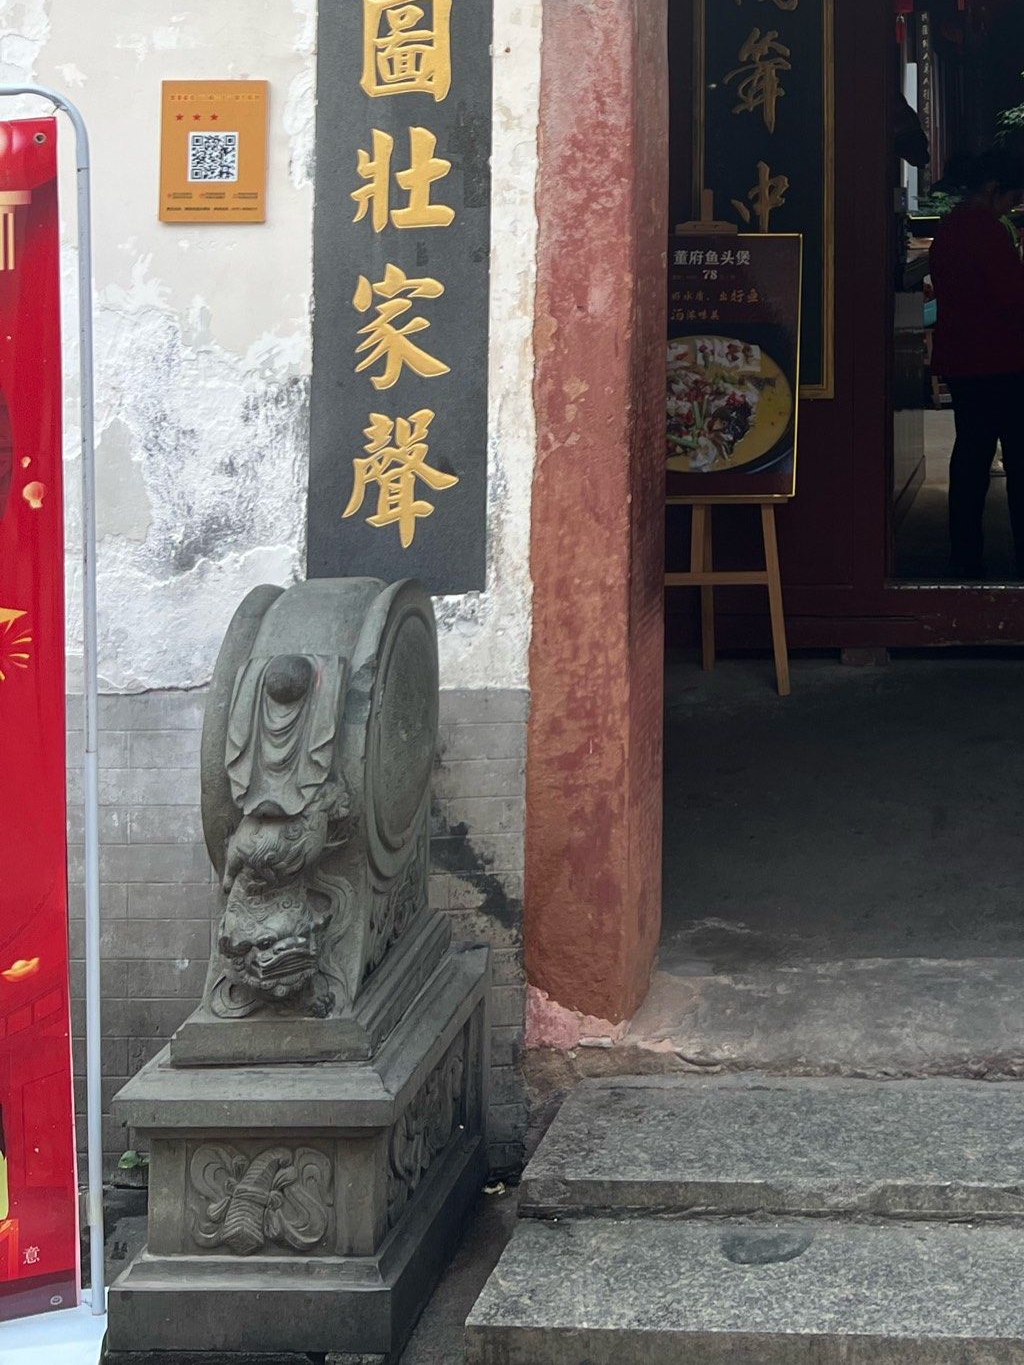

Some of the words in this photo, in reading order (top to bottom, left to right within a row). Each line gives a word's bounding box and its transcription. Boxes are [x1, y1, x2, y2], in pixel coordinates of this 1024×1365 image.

[673, 249, 751, 267] 董府鱼头煲
[702, 268, 718, 280] 78
[23, 1246, 40, 1264] 意
